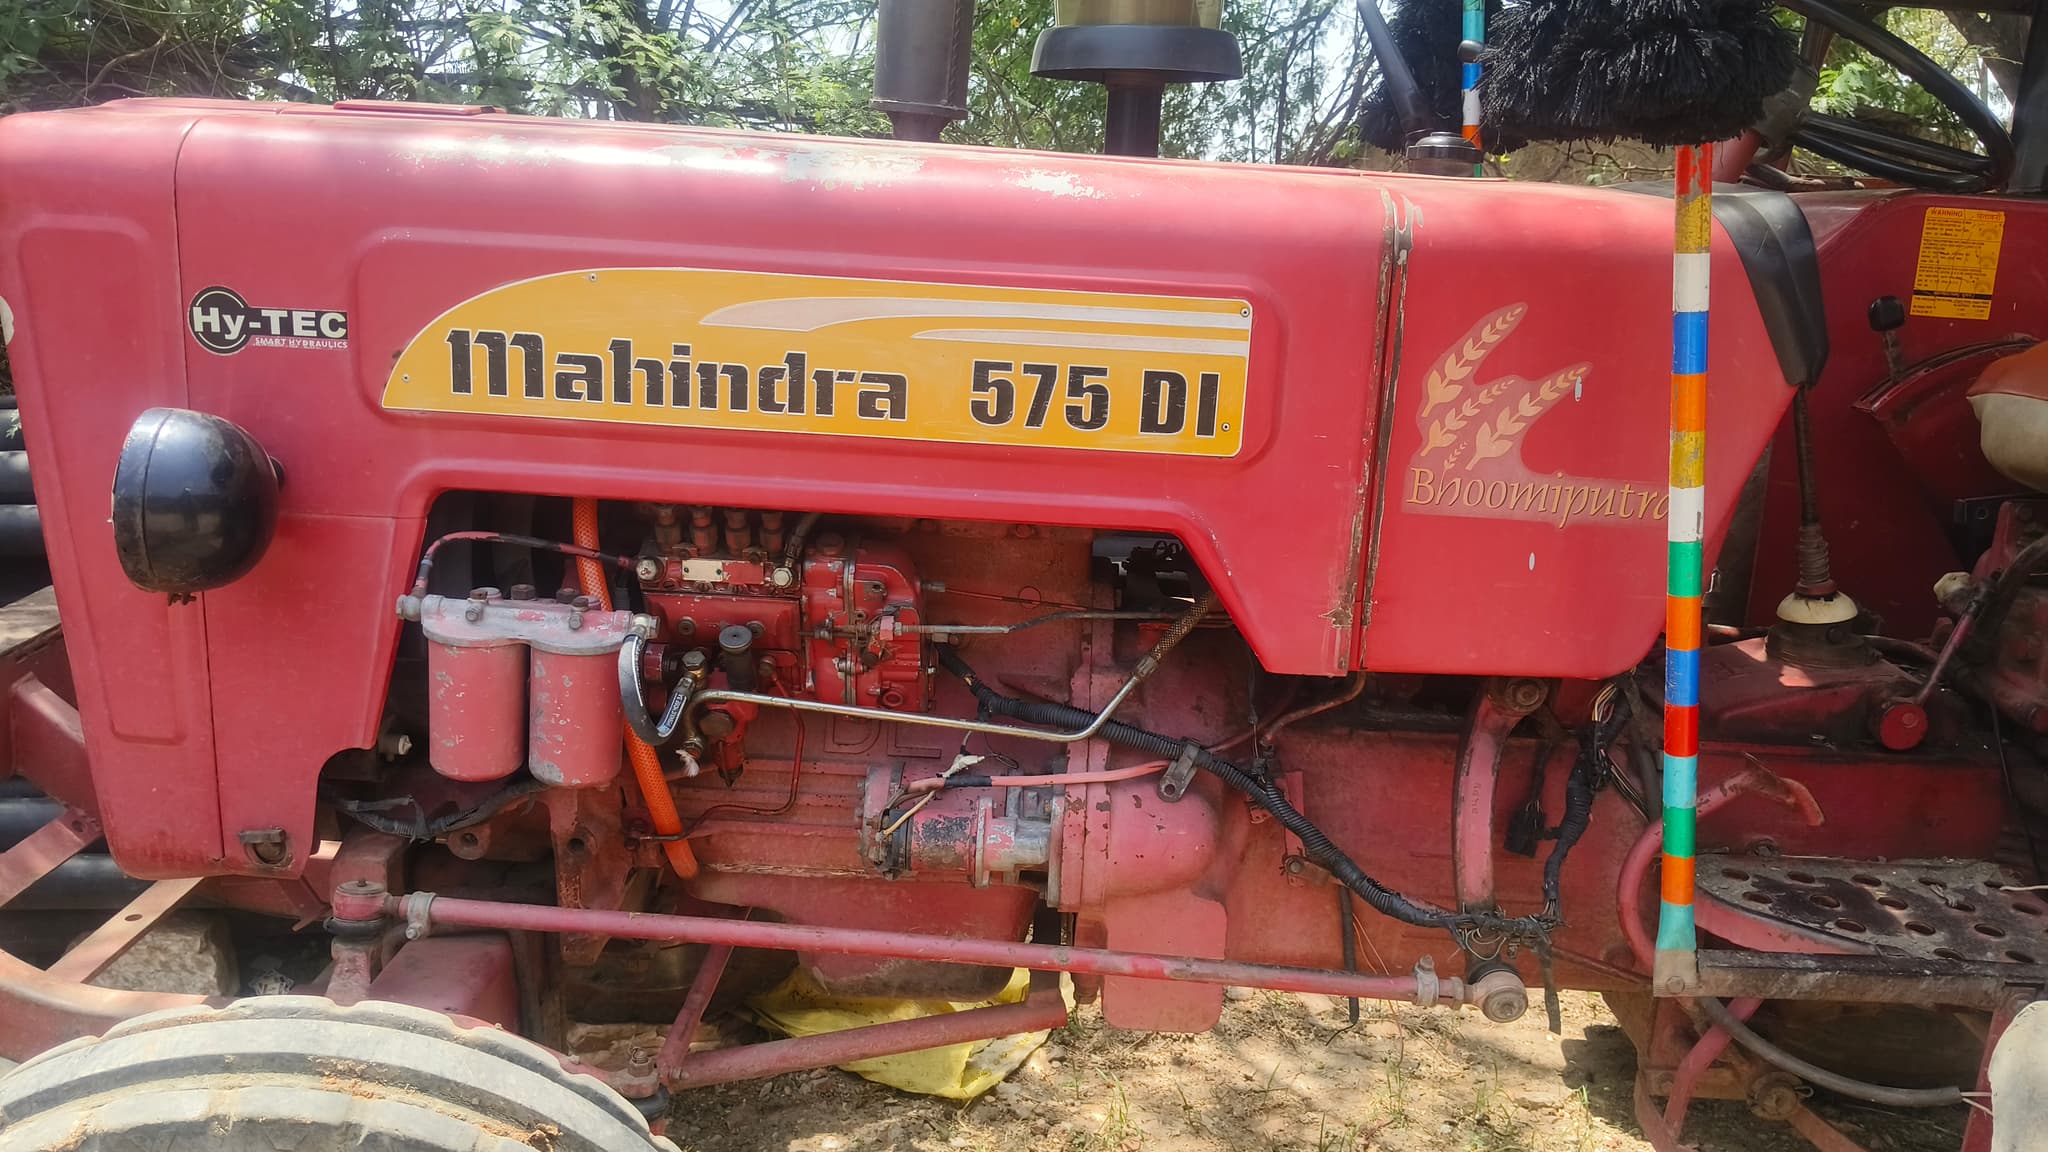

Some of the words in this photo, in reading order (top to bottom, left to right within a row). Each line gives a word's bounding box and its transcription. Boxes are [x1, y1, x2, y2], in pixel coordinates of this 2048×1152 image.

[1930, 208, 1963, 217] WARNING
[192, 306, 348, 340] Hy-TEC
[254, 337, 286, 346] SMART
[289, 338, 348, 349] HYDRAULICS
[445, 329, 909, 421] Mahindra
[969, 360, 1109, 431] 575
[1140, 369, 1219, 438] DI
